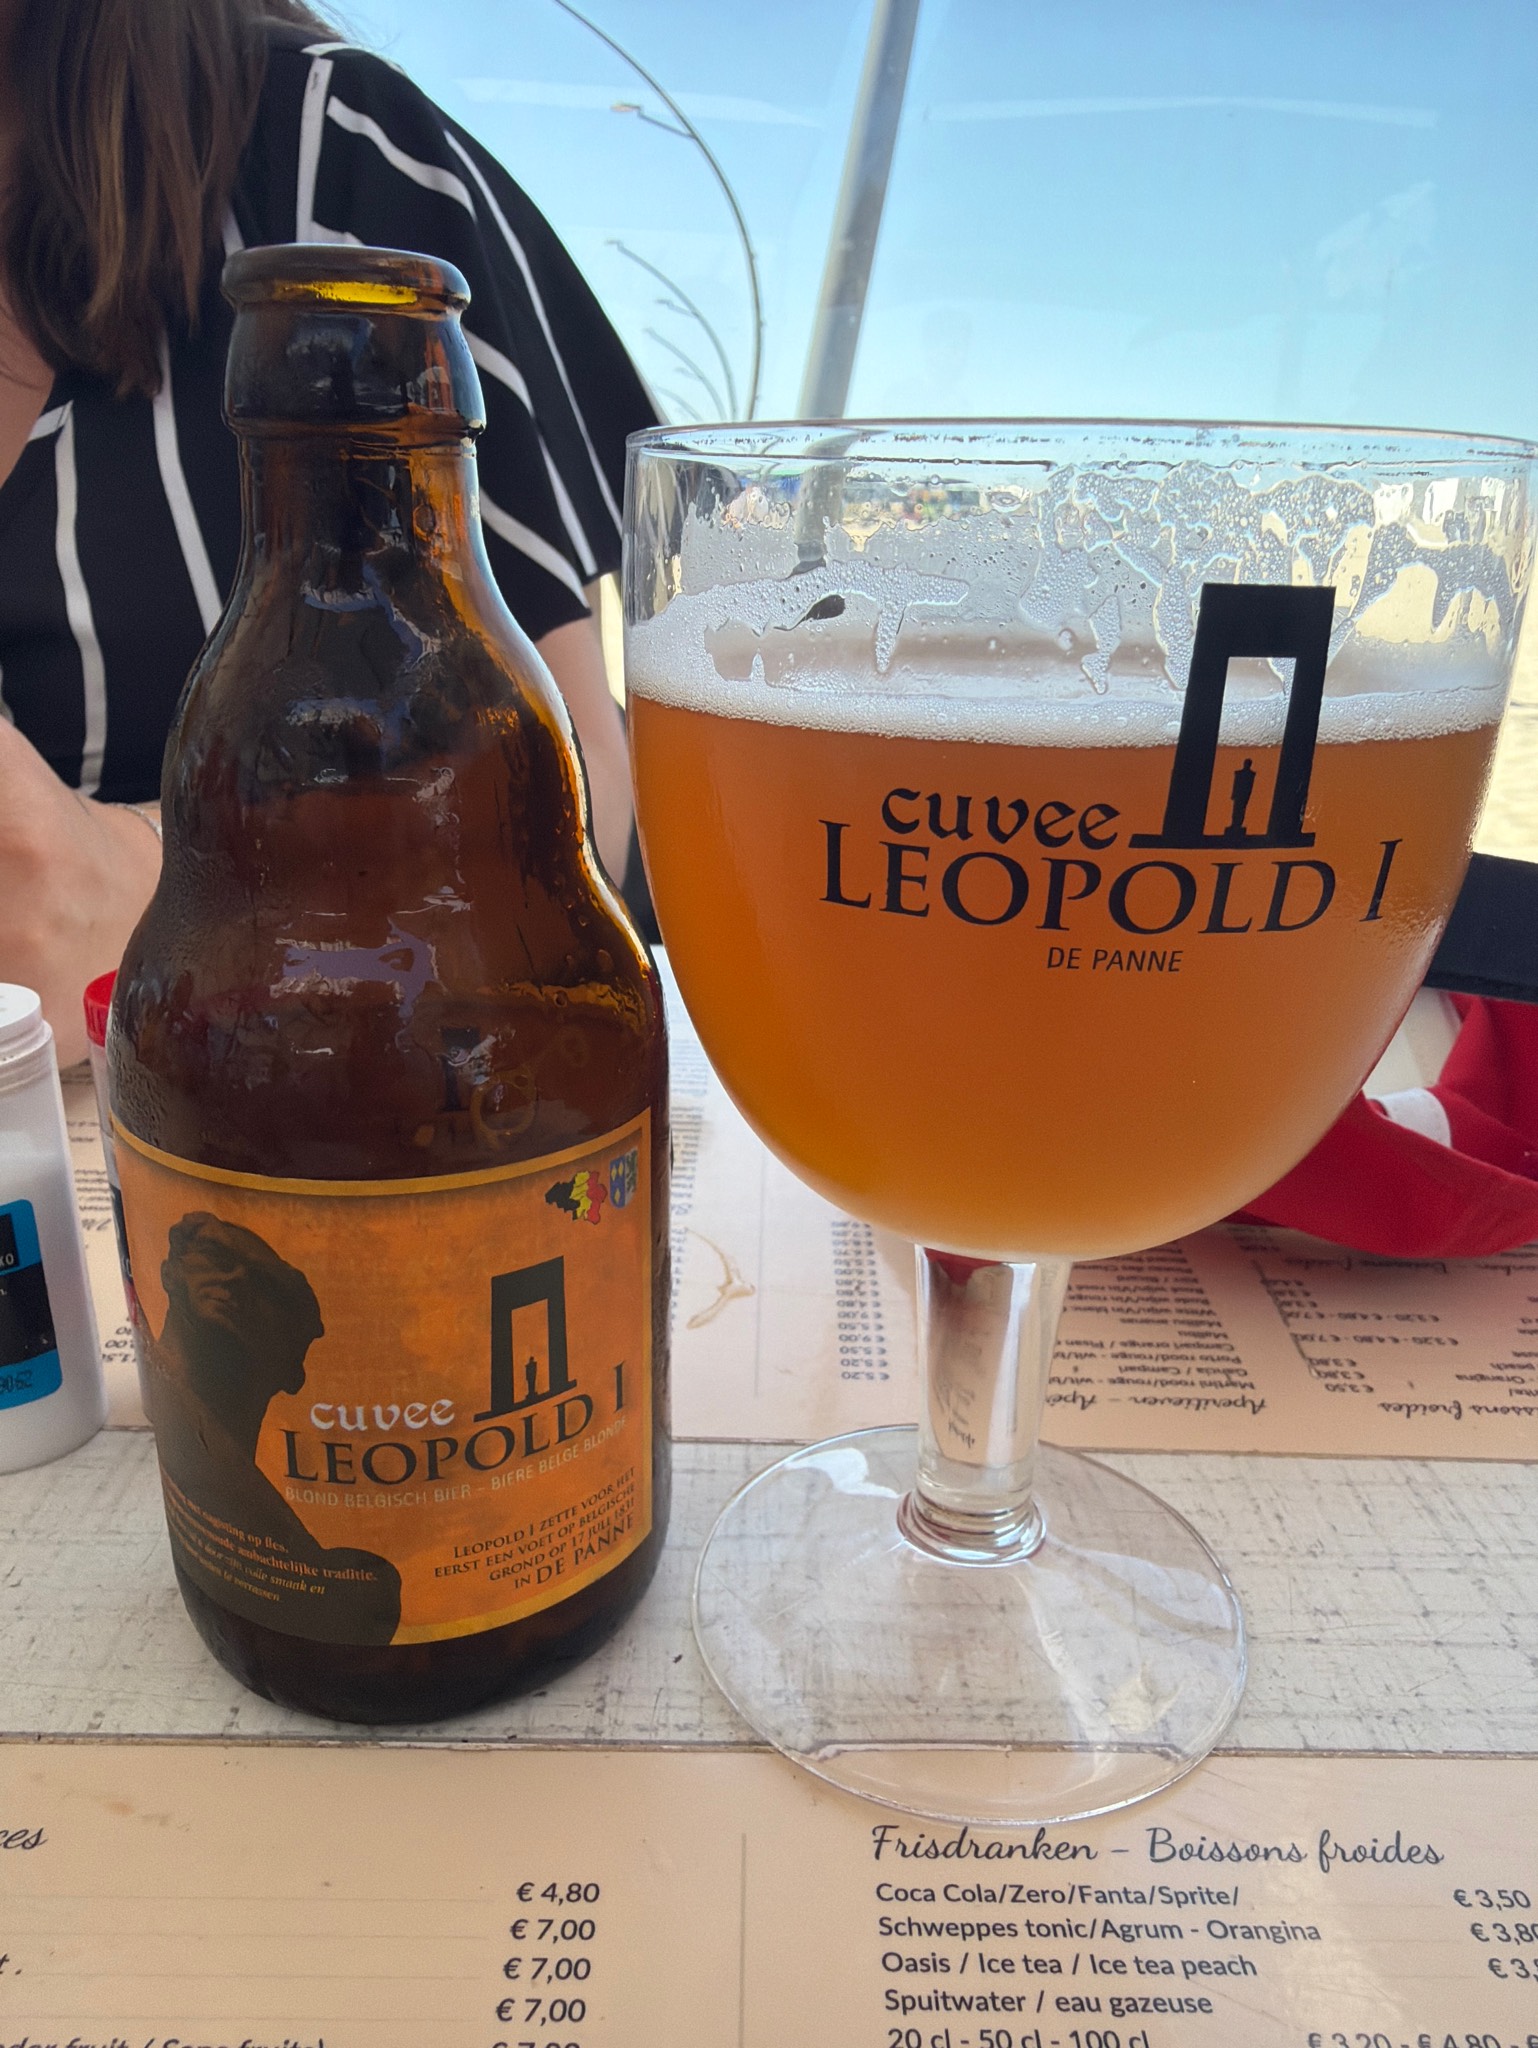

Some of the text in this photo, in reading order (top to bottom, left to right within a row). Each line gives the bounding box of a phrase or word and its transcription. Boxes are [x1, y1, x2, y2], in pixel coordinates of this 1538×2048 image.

[882, 788, 1120, 850] cuvee
[819, 819, 1404, 935] LEOPOLD I
[1047, 946, 1183, 973] DE PANNE
[279, 1362, 625, 1486] LEOPOLD I
[309, 1399, 455, 1432] cuvee
[1379, 1401, 1462, 1420] froides
[285, 1486, 339, 1507] BLOND
[344, 1491, 427, 1510] BELGISCH
[434, 1484, 472, 1502] BIER
[538, 1447, 579, 1475] BELGE
[453, 1529, 525, 1559] LEOPOLD
[540, 1505, 578, 1531] ZETTE
[580, 1484, 614, 1510] VOOR
[616, 1466, 636, 1488] HET
[434, 1560, 480, 1578] EERST
[486, 1549, 514, 1567] EEN
[517, 1534, 553, 1556] VOET
[558, 1521, 576, 1538] OP
[489, 1553, 545, 1581] GROND
[549, 1541, 568, 1559] OP
[571, 1533, 585, 1548] 17
[586, 1518, 611, 1543] JULI
[514, 1512, 635, 1589] IN DE PANNE
[871, 1824, 1099, 1861] Frisdranken
[1145, 1827, 1308, 1863] Boissons
[1318, 1830, 1446, 1873] froides
[540, 1882, 600, 1906] 4,80
[876, 1883, 936, 1902] Coca
[943, 1883, 1239, 1908] Cola/Zero/Fanta/Sprite/
[1475, 1889, 1531, 1911] 3,50
[537, 1918, 596, 1944] 7,00
[879, 1916, 1018, 1942] Schweppes
[1206, 1919, 1322, 1946] Orangina
[531, 1958, 591, 1984] 7,00
[882, 1952, 951, 1974] Oasis
[979, 1953, 1016, 1974] Ice
[1022, 1954, 1063, 1974] tea
[1090, 1954, 1128, 1975] Ice
[1133, 1955, 1175, 1976] tea
[1181, 1955, 1258, 1980] peach
[524, 1998, 586, 2026] 7,00
[884, 1989, 1026, 2016] Spuitwater
[1055, 1997, 1103, 2013] eau
[1109, 1997, 1214, 2018] gazeuse
[888, 2028, 922, 2048] 20
[930, 2029, 950, 2048] cl
[979, 2030, 1013, 2048] 50
[1021, 2029, 1042, 2048] cl
[1069, 2030, 1121, 2048] 100
[1128, 2030, 1150, 2048] cl
